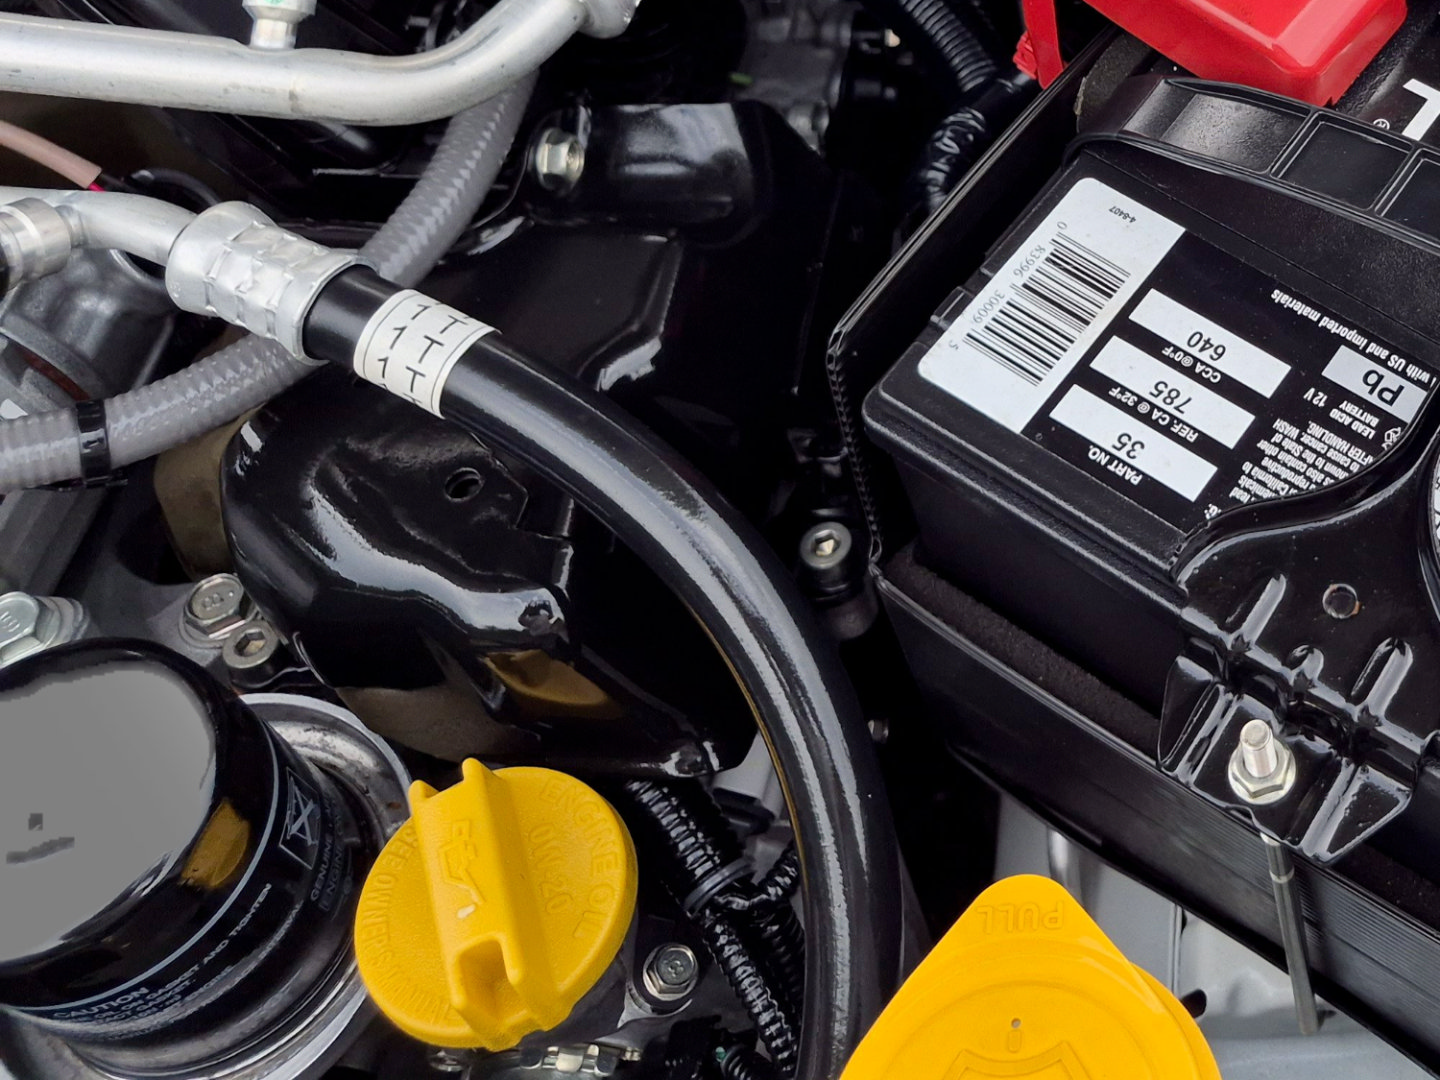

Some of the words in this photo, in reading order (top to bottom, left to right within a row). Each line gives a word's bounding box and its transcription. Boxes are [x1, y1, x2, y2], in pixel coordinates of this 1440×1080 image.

[1270, 288, 1321, 321] materials
[1318, 316, 1367, 349] imported
[1186, 330, 1226, 361] 640
[1365, 341, 1389, 359] and
[1194, 361, 1221, 383] CCA
[1386, 354, 1406, 371] US
[1405, 363, 1430, 383] with
[1108, 386, 1138, 406] 32°F
[1148, 380, 1192, 414] 785
[1302, 387, 1315, 401] V
[1362, 369, 1404, 406] Pb
[1136, 401, 1150, 413] @
[1311, 391, 1327, 407] 12
[1151, 407, 1170, 425] CA
[1329, 407, 1353, 425] ACID
[1338, 400, 1379, 427] BATTERY
[1170, 419, 1198, 442] REF.
[1270, 432, 1283, 443] of
[1272, 418, 1299, 440] WASH
[1306, 420, 1350, 453] HANDLING.
[1350, 420, 1375, 439] LEAD
[1111, 432, 1145, 459] 35
[1256, 439, 1279, 456] other
[1281, 437, 1303, 457] State
[1299, 431, 1328, 454] cancer.
[1087, 444, 1110, 465] NO.
[1276, 450, 1307, 474] contain
[1301, 448, 1317, 464] the
[1314, 456, 1326, 470] to
[1325, 447, 1351, 467] cause
[1106, 459, 1142, 485] PART
[1241, 460, 1253, 474] to
[1260, 452, 1309, 489] reproductive
[1302, 466, 1325, 483] also
[1323, 461, 1349, 480] nown
[1348, 461, 1360, 473] to
[1250, 466, 1289, 496] California
[1228, 486, 1250, 503] lead
[539, 777, 621, 875] ENGINE
[572, 884, 616, 940] OIL
[973, 899, 1065, 935] PULL
[53, 986, 149, 1018] CAUTION
